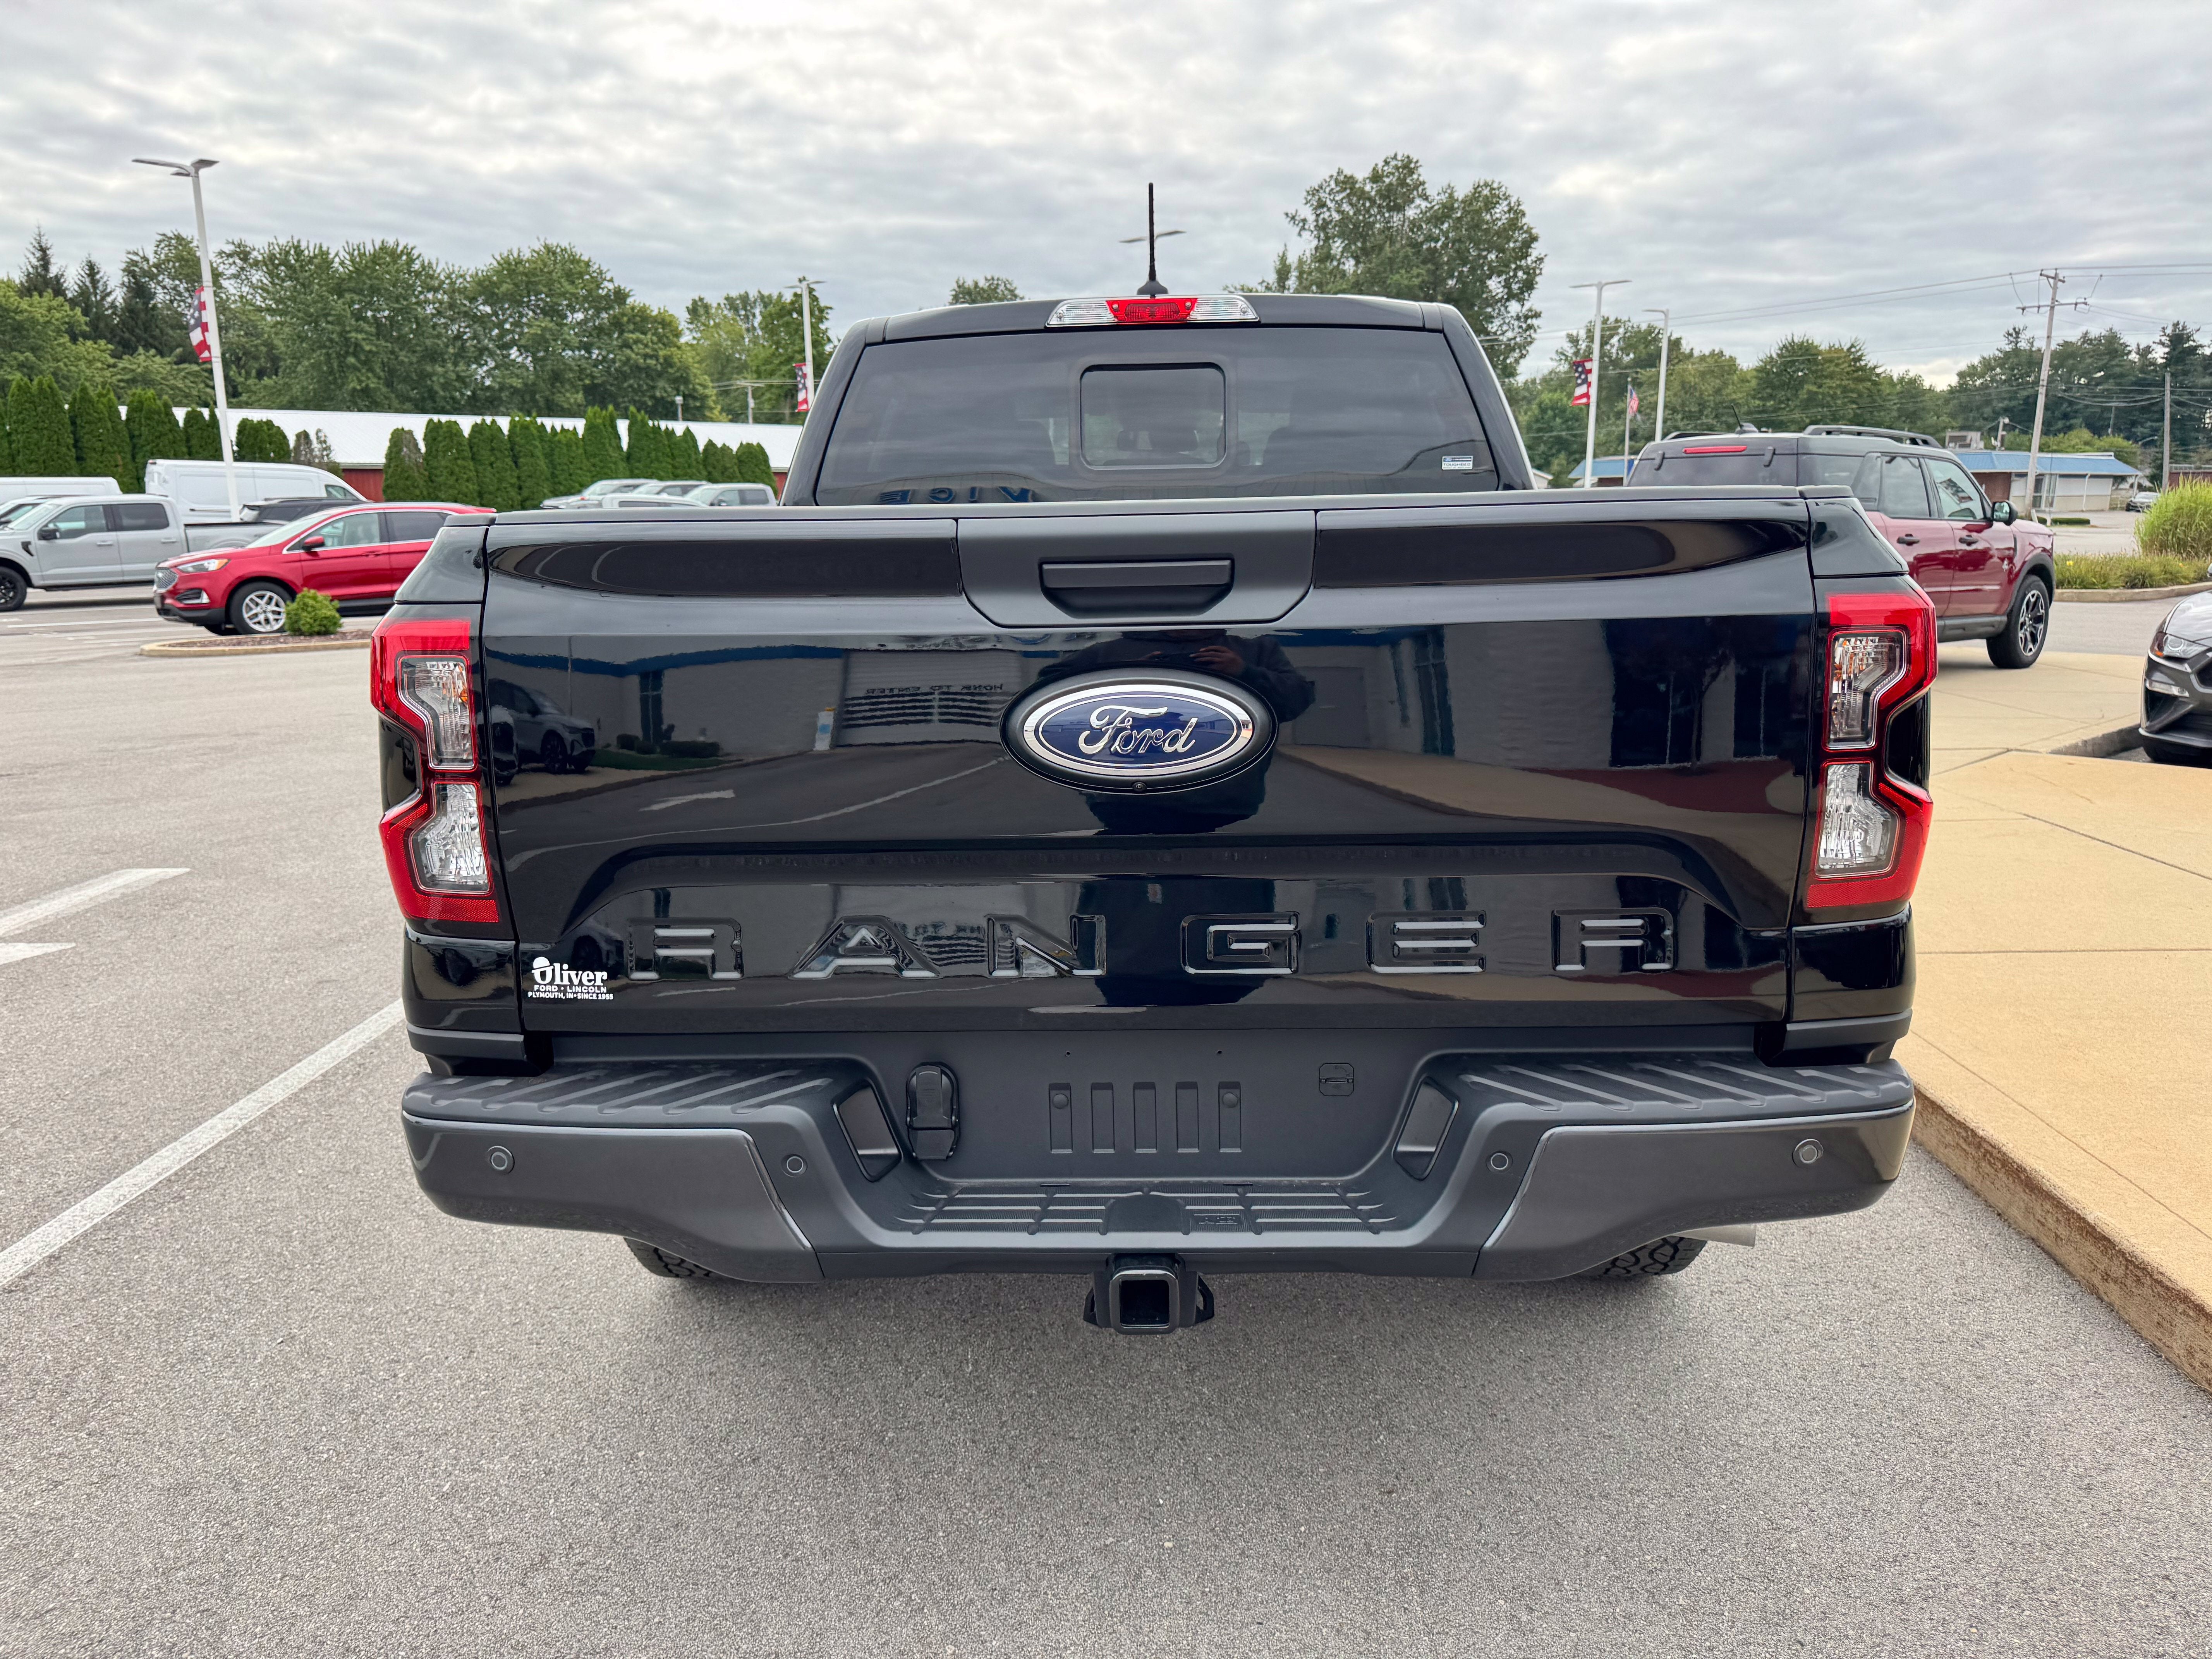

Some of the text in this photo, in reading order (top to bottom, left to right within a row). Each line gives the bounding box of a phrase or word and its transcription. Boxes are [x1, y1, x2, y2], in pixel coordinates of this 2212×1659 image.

[1078, 705, 1198, 754] Ford
[627, 907, 1675, 979] RANGER
[532, 957, 608, 986] Oliver
